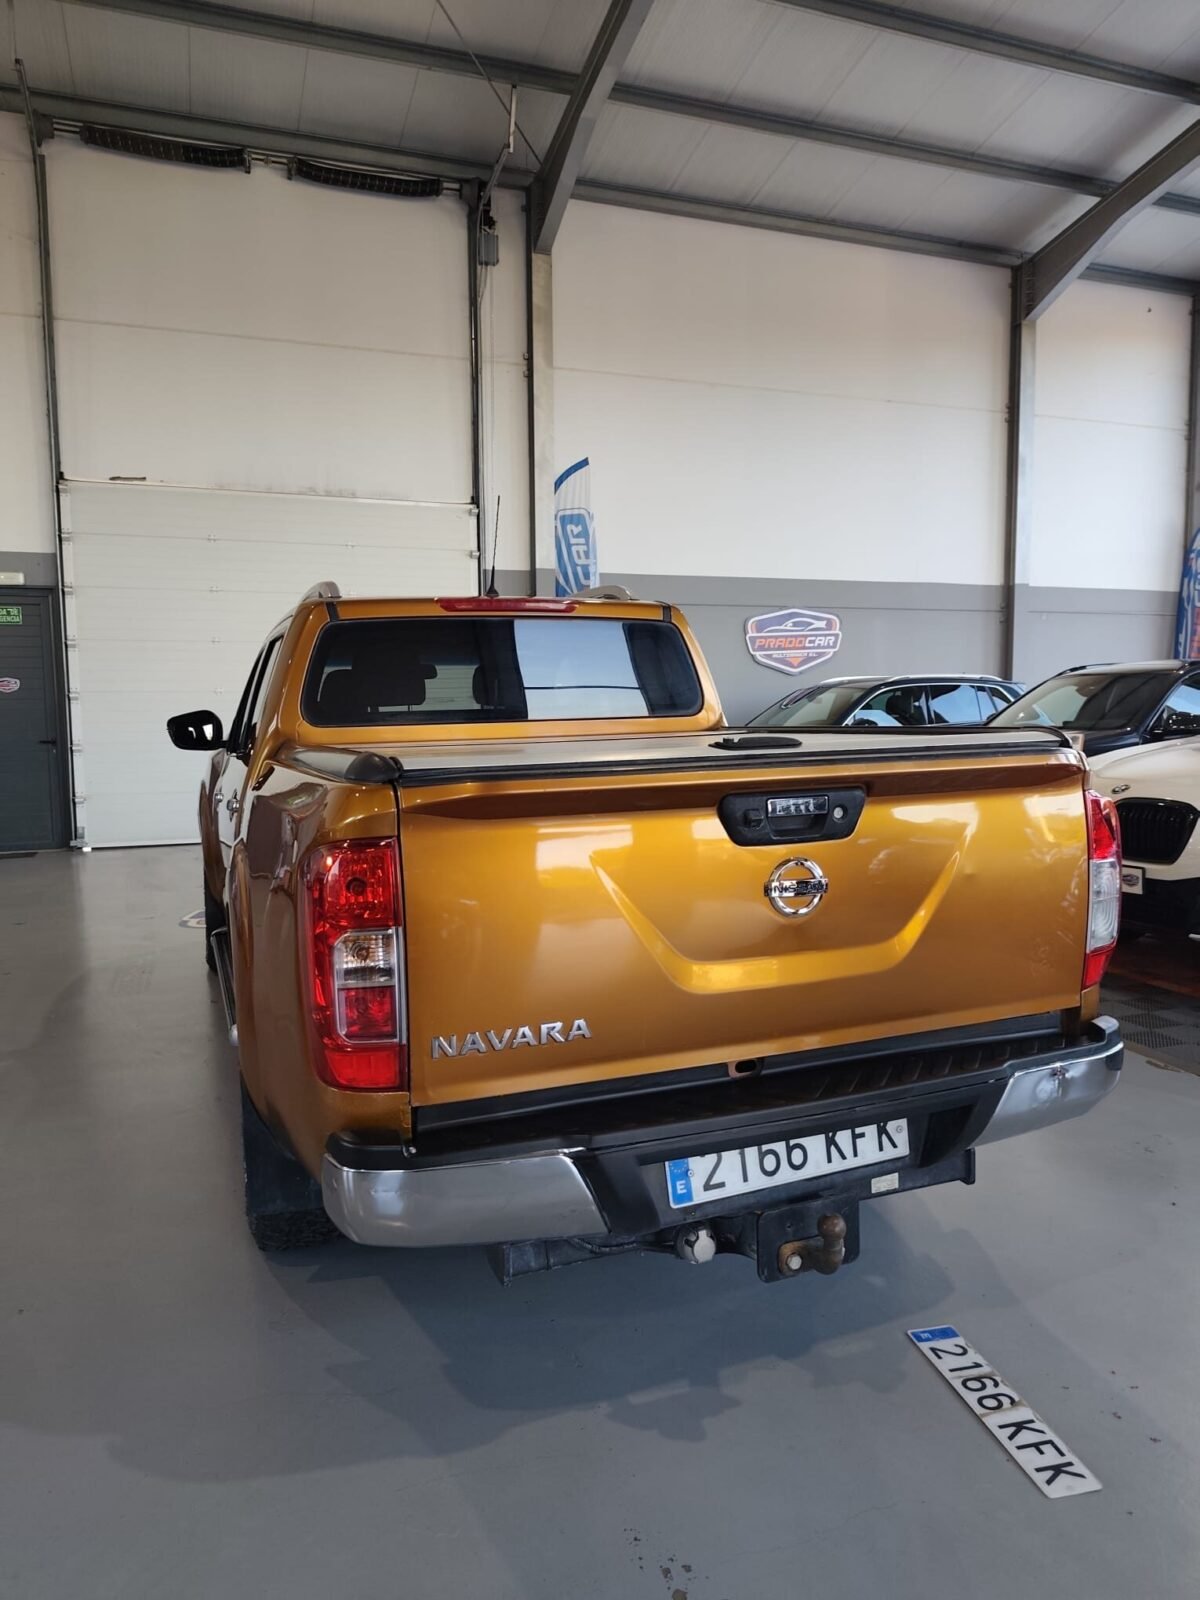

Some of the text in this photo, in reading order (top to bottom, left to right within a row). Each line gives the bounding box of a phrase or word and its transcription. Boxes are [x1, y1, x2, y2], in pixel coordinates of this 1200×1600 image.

[566, 523, 597, 586] CAR
[754, 636, 835, 649] PRADOCAR
[431, 1018, 592, 1059] NAVARA
[676, 1121, 898, 1194] E 2166 KFK
[928, 1343, 1016, 1411] 2166
[997, 1418, 1087, 1486] KFK
